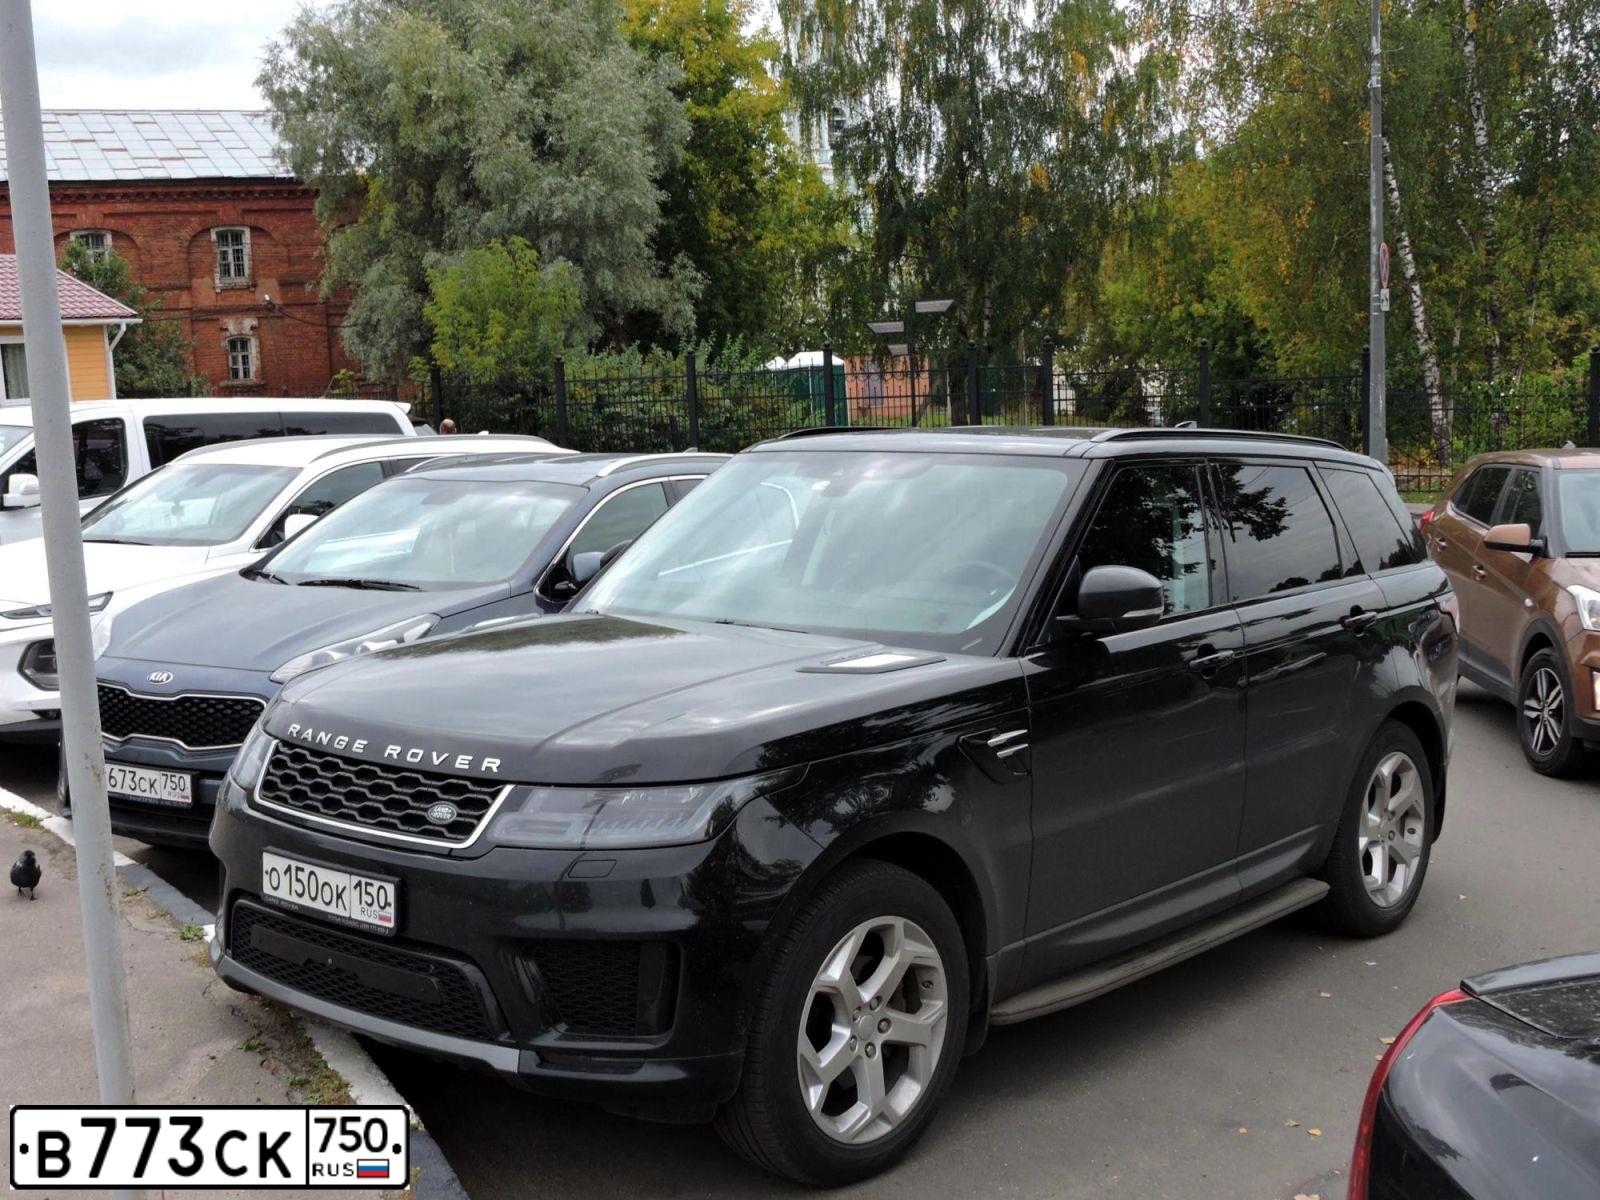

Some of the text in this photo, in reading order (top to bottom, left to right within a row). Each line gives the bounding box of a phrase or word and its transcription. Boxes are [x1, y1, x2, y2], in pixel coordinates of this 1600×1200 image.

[148, 671, 170, 682] KIA
[287, 723, 501, 772] RANGE ROVER
[107, 768, 186, 795] 673CK 750
[353, 879, 388, 910] 150
[360, 906, 378, 920] RUS
